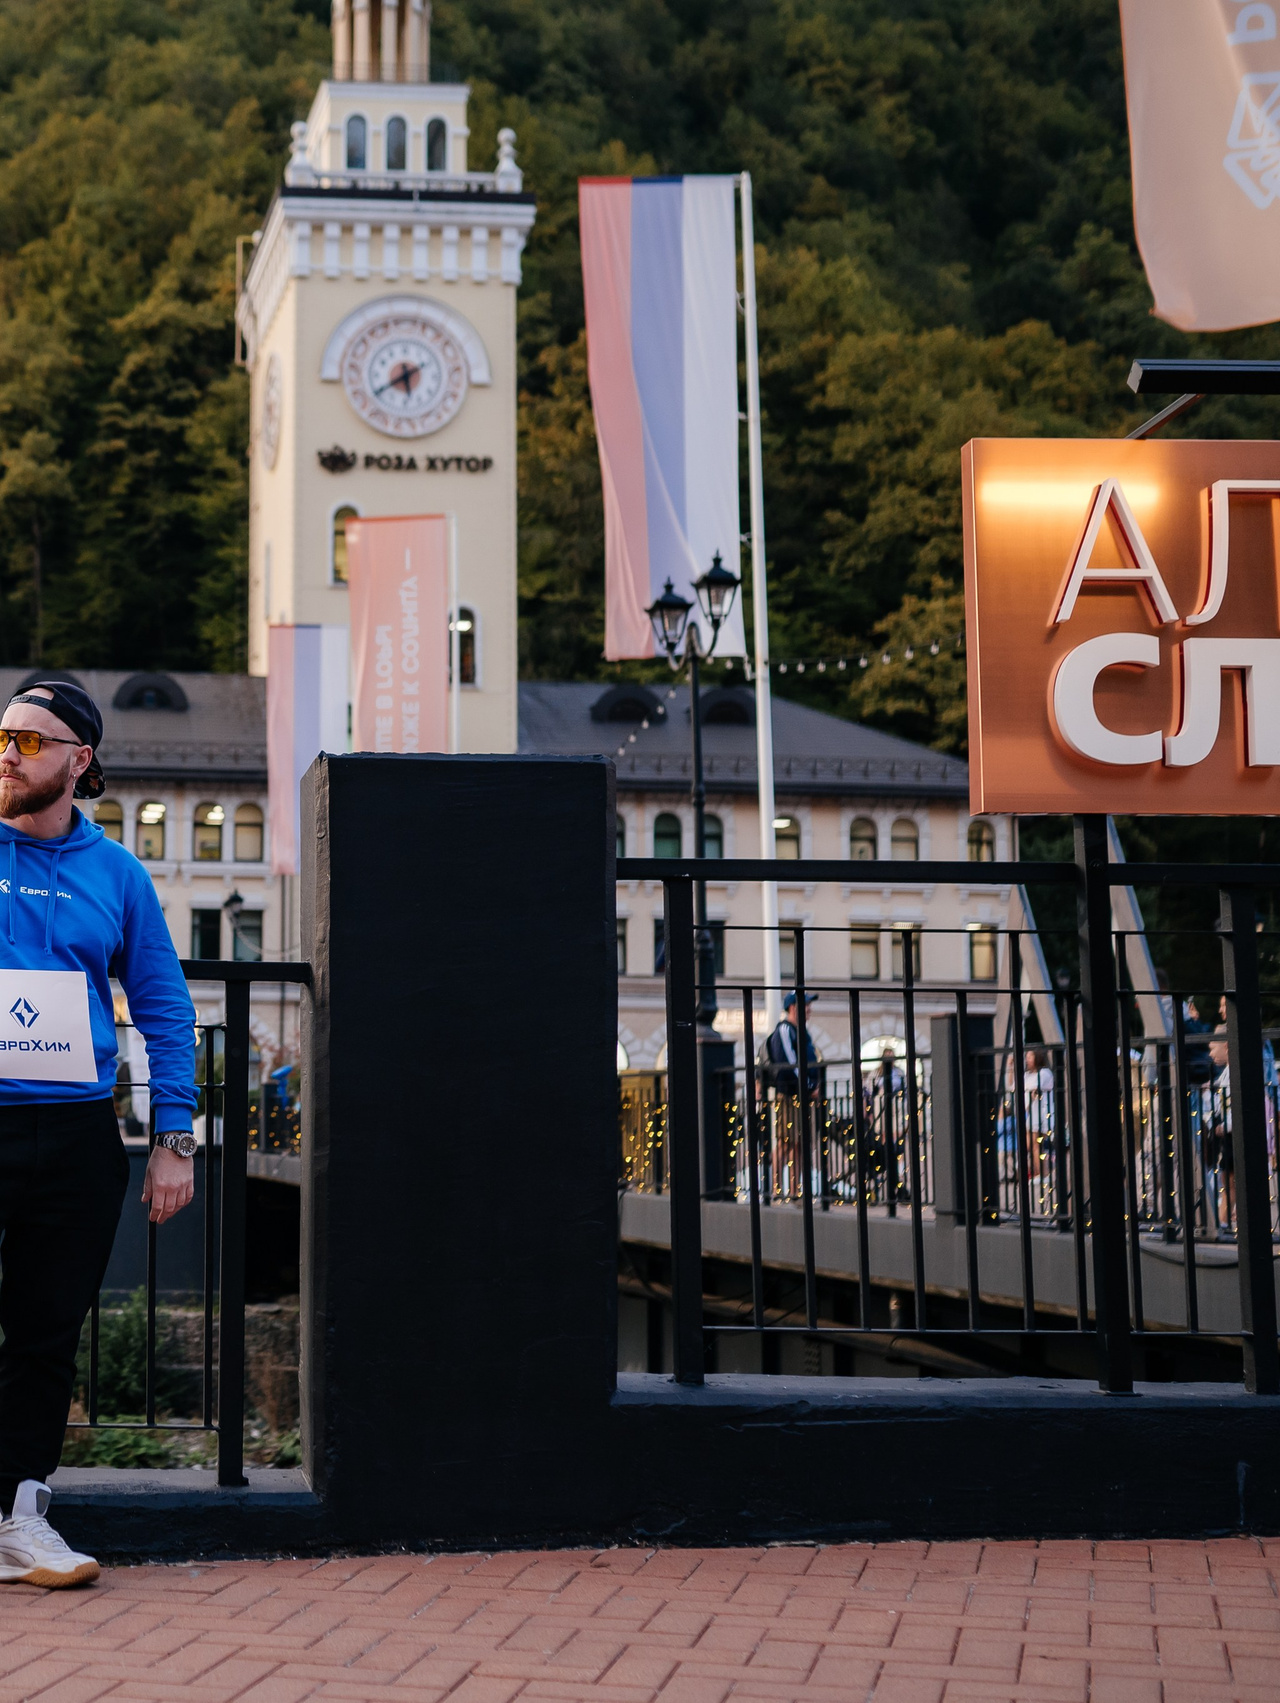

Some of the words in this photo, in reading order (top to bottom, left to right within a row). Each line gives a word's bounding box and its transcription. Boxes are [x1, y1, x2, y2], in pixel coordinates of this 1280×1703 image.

[363, 454, 419, 472] РОЗА
[425, 455, 494, 473] ХУТОР
[1053, 632, 1280, 767] СЛ
[19, 886, 72, 900] Евроим
